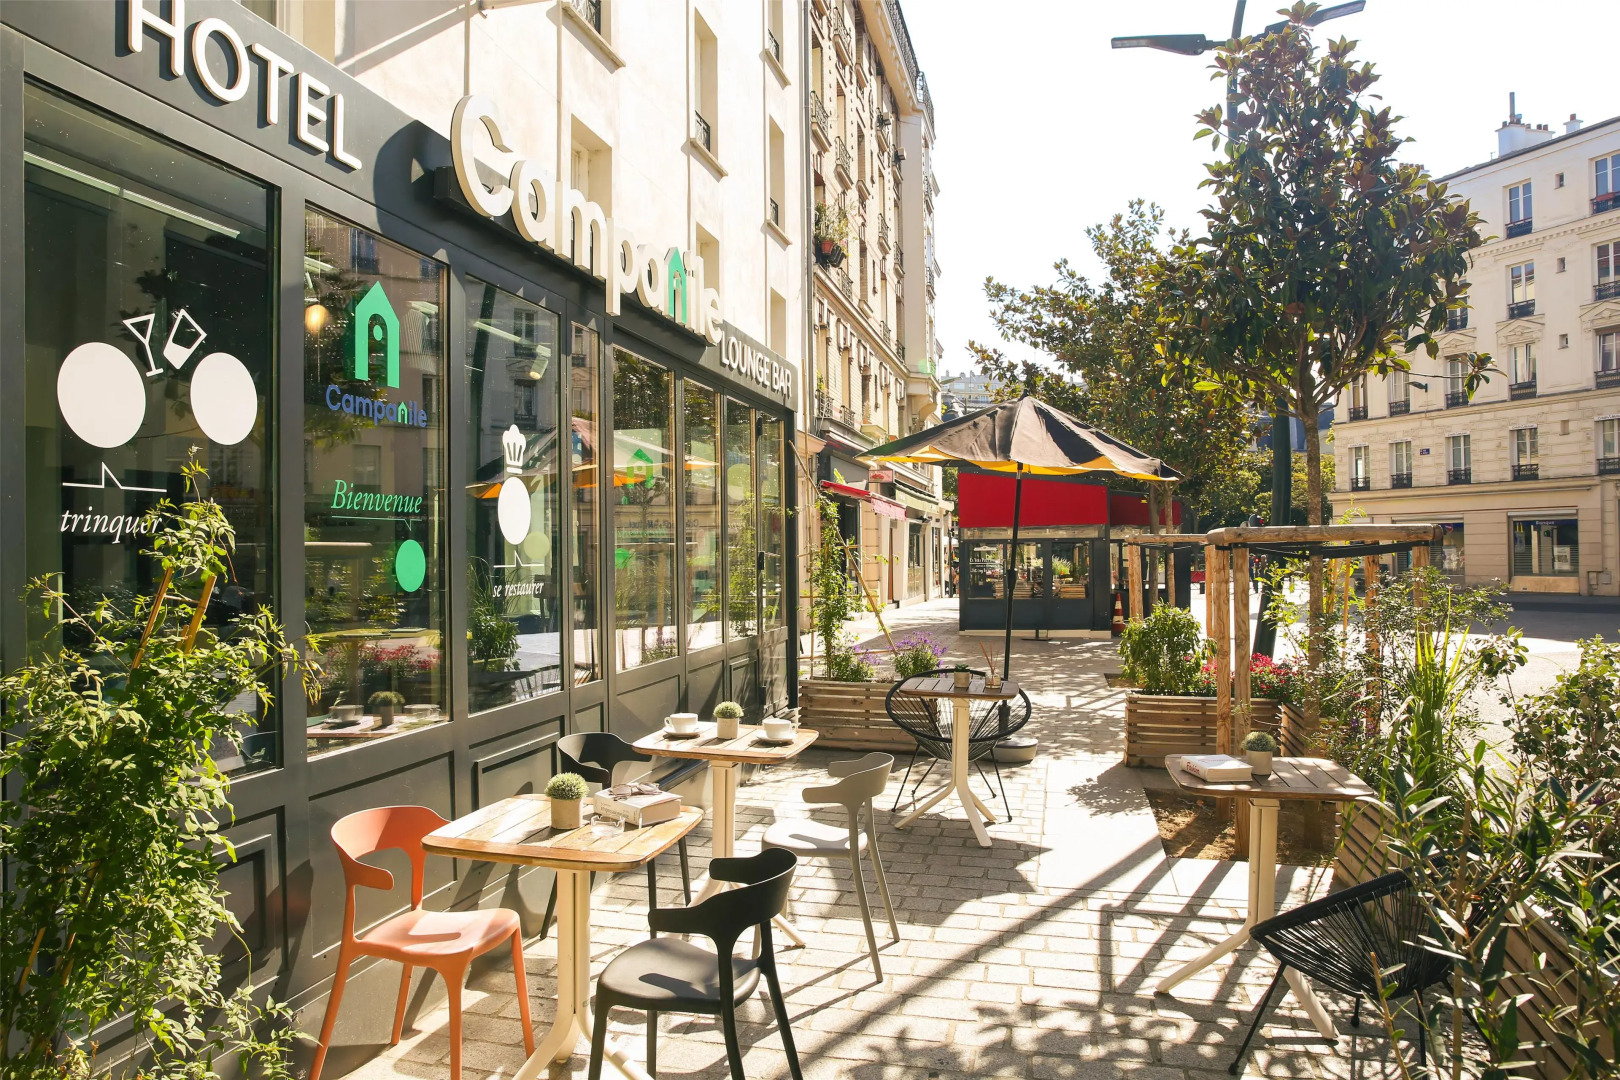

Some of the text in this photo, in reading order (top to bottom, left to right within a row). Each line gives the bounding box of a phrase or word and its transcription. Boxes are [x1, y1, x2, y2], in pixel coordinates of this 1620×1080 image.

[129, 0, 362, 170] HOTEL
[451, 95, 724, 344] Campanile
[721, 331, 792, 397] LOUNGE BAR
[326, 384, 428, 427] Campanile
[331, 479, 423, 514] Bienvenue
[492, 581, 545, 598] se restaurer
